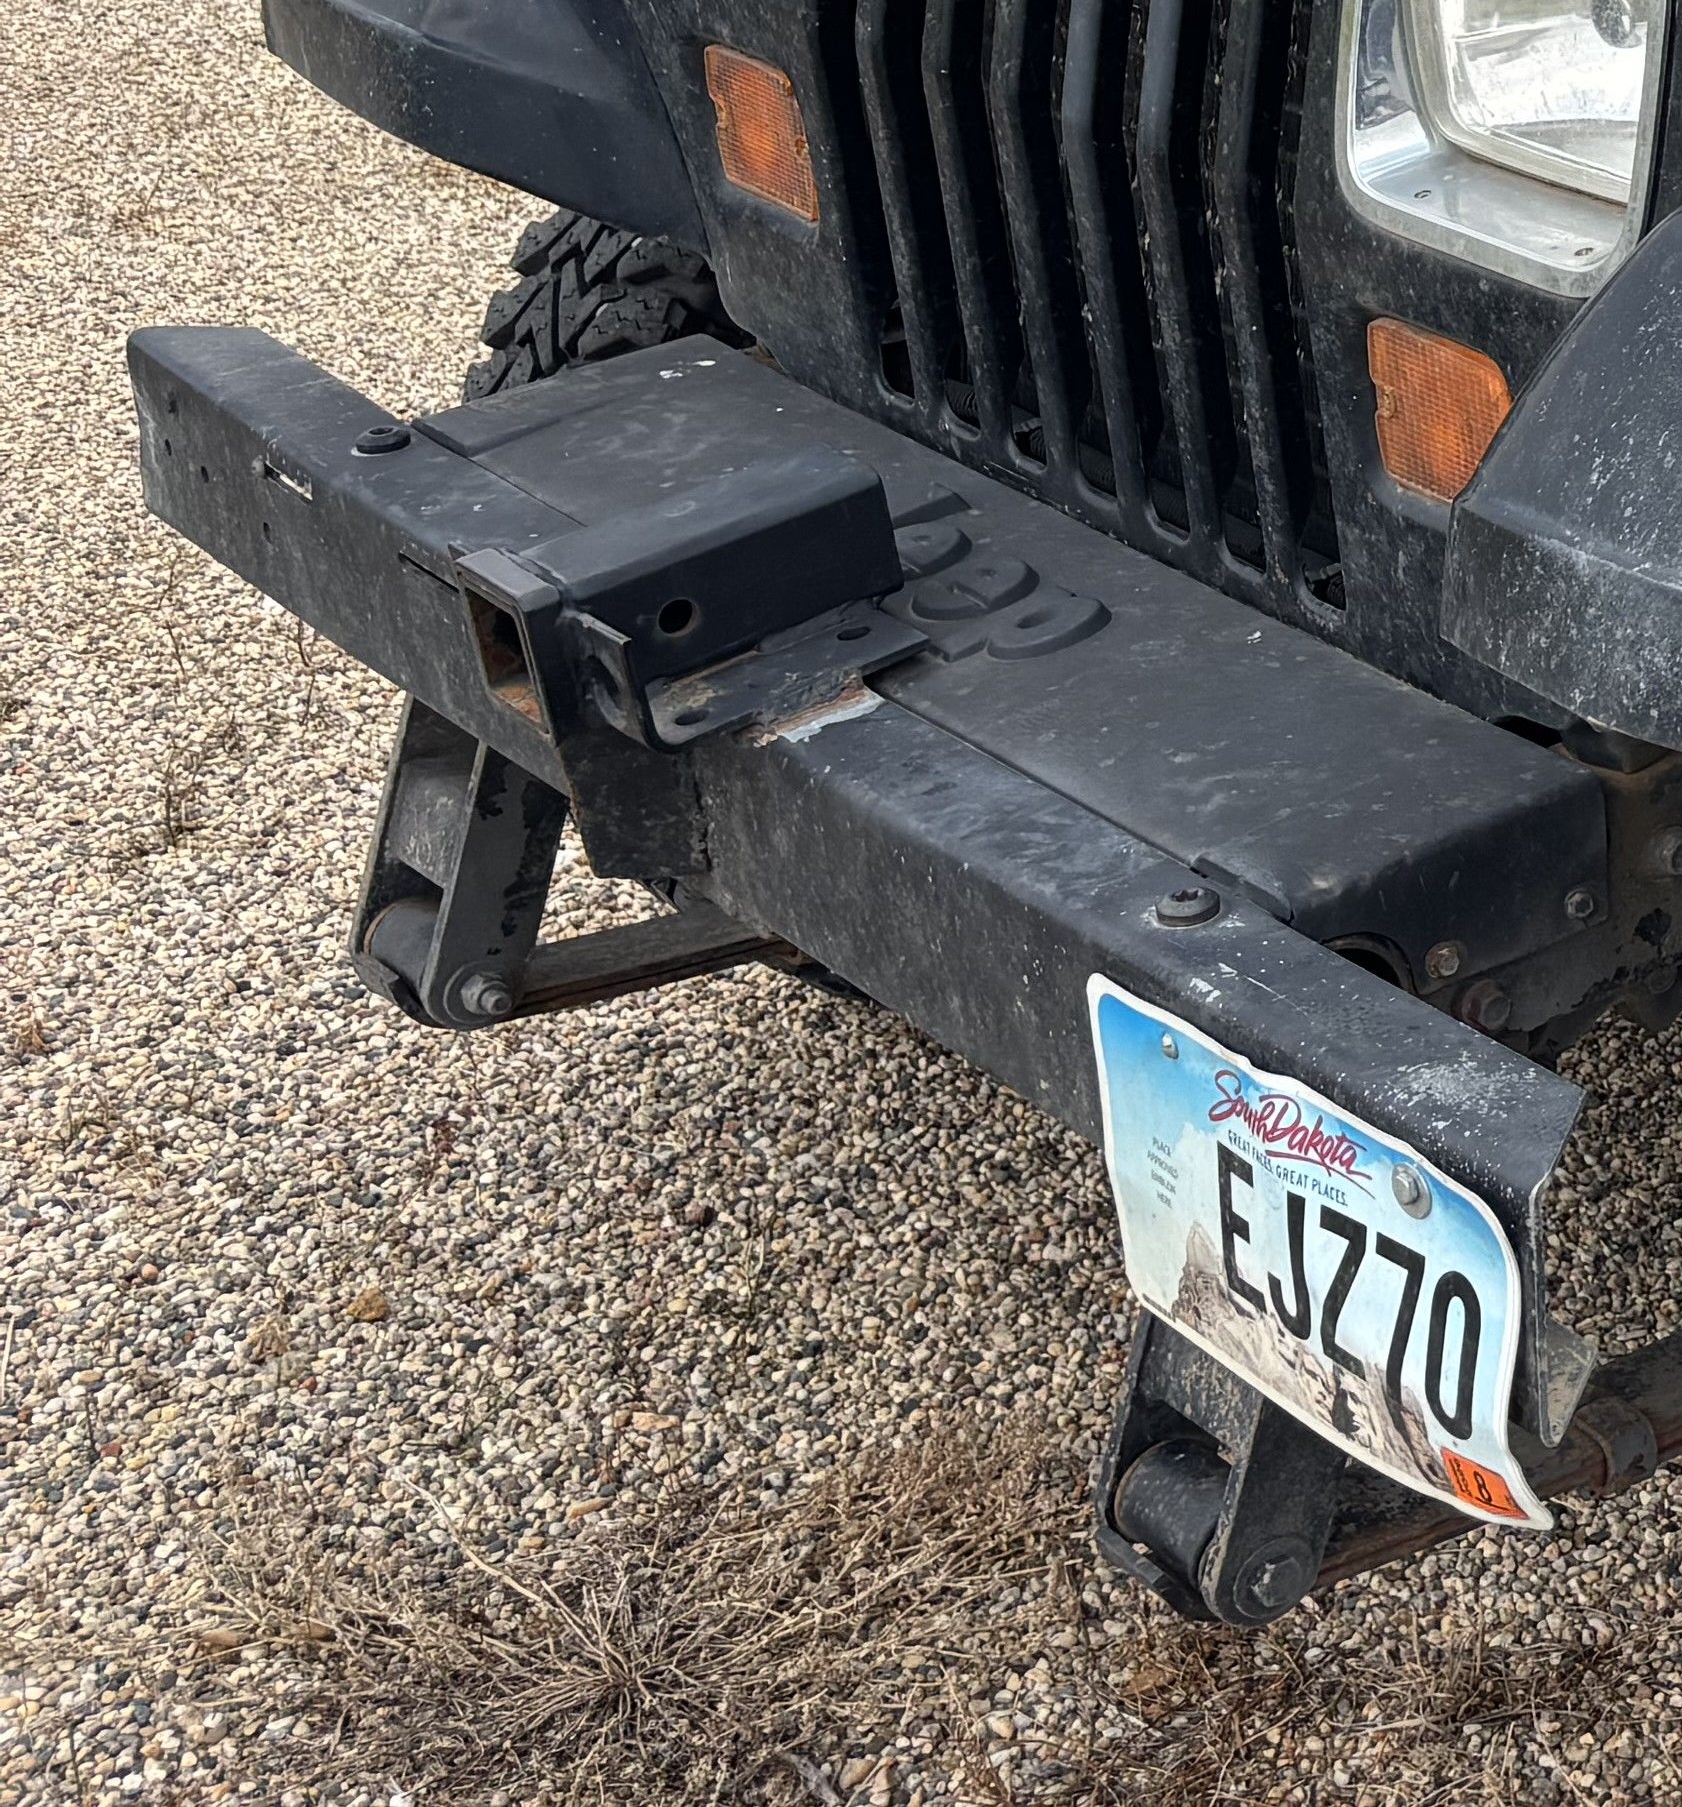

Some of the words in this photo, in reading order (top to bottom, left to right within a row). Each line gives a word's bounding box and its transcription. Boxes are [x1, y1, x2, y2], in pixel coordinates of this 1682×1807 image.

[1208, 1069, 1276, 1142] South
[1259, 1094, 1373, 1180] Dakota
[1228, 1129, 1250, 1155] GREAT
[1276, 1165, 1308, 1187] GREAT
[1217, 1140, 1481, 1440] EJZ70
